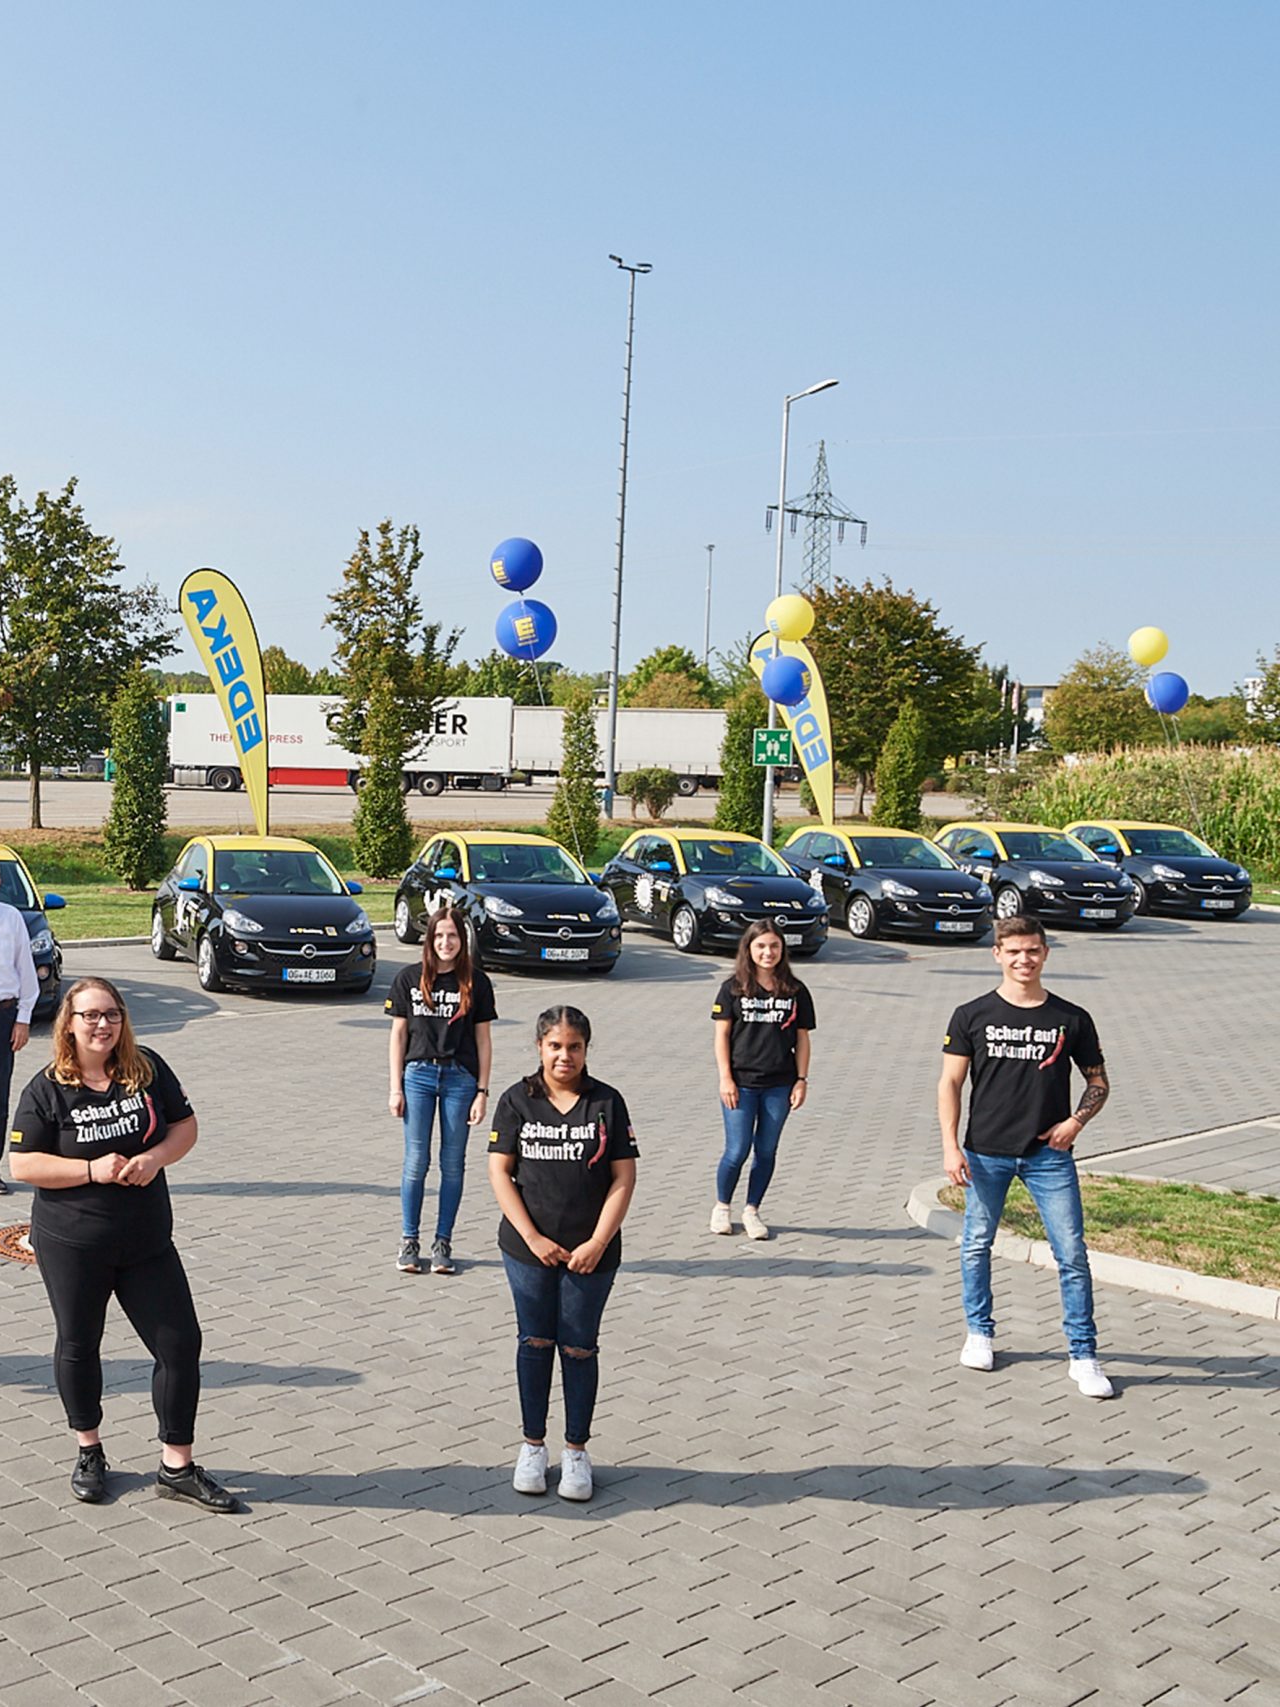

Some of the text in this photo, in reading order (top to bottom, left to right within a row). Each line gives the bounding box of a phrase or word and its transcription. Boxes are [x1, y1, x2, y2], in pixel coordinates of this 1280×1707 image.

[740, 996, 792, 1010] Scharf auf
[741, 1010, 784, 1023] Zukunft?
[985, 1025, 1058, 1043] Scharf auf
[986, 1043, 1046, 1060] Zukunft?
[70, 1092, 145, 1124] Scharf auf
[76, 1114, 140, 1143] Zukunft?
[520, 1121, 596, 1139] Scharf auf
[520, 1141, 584, 1160] Zukunft?
